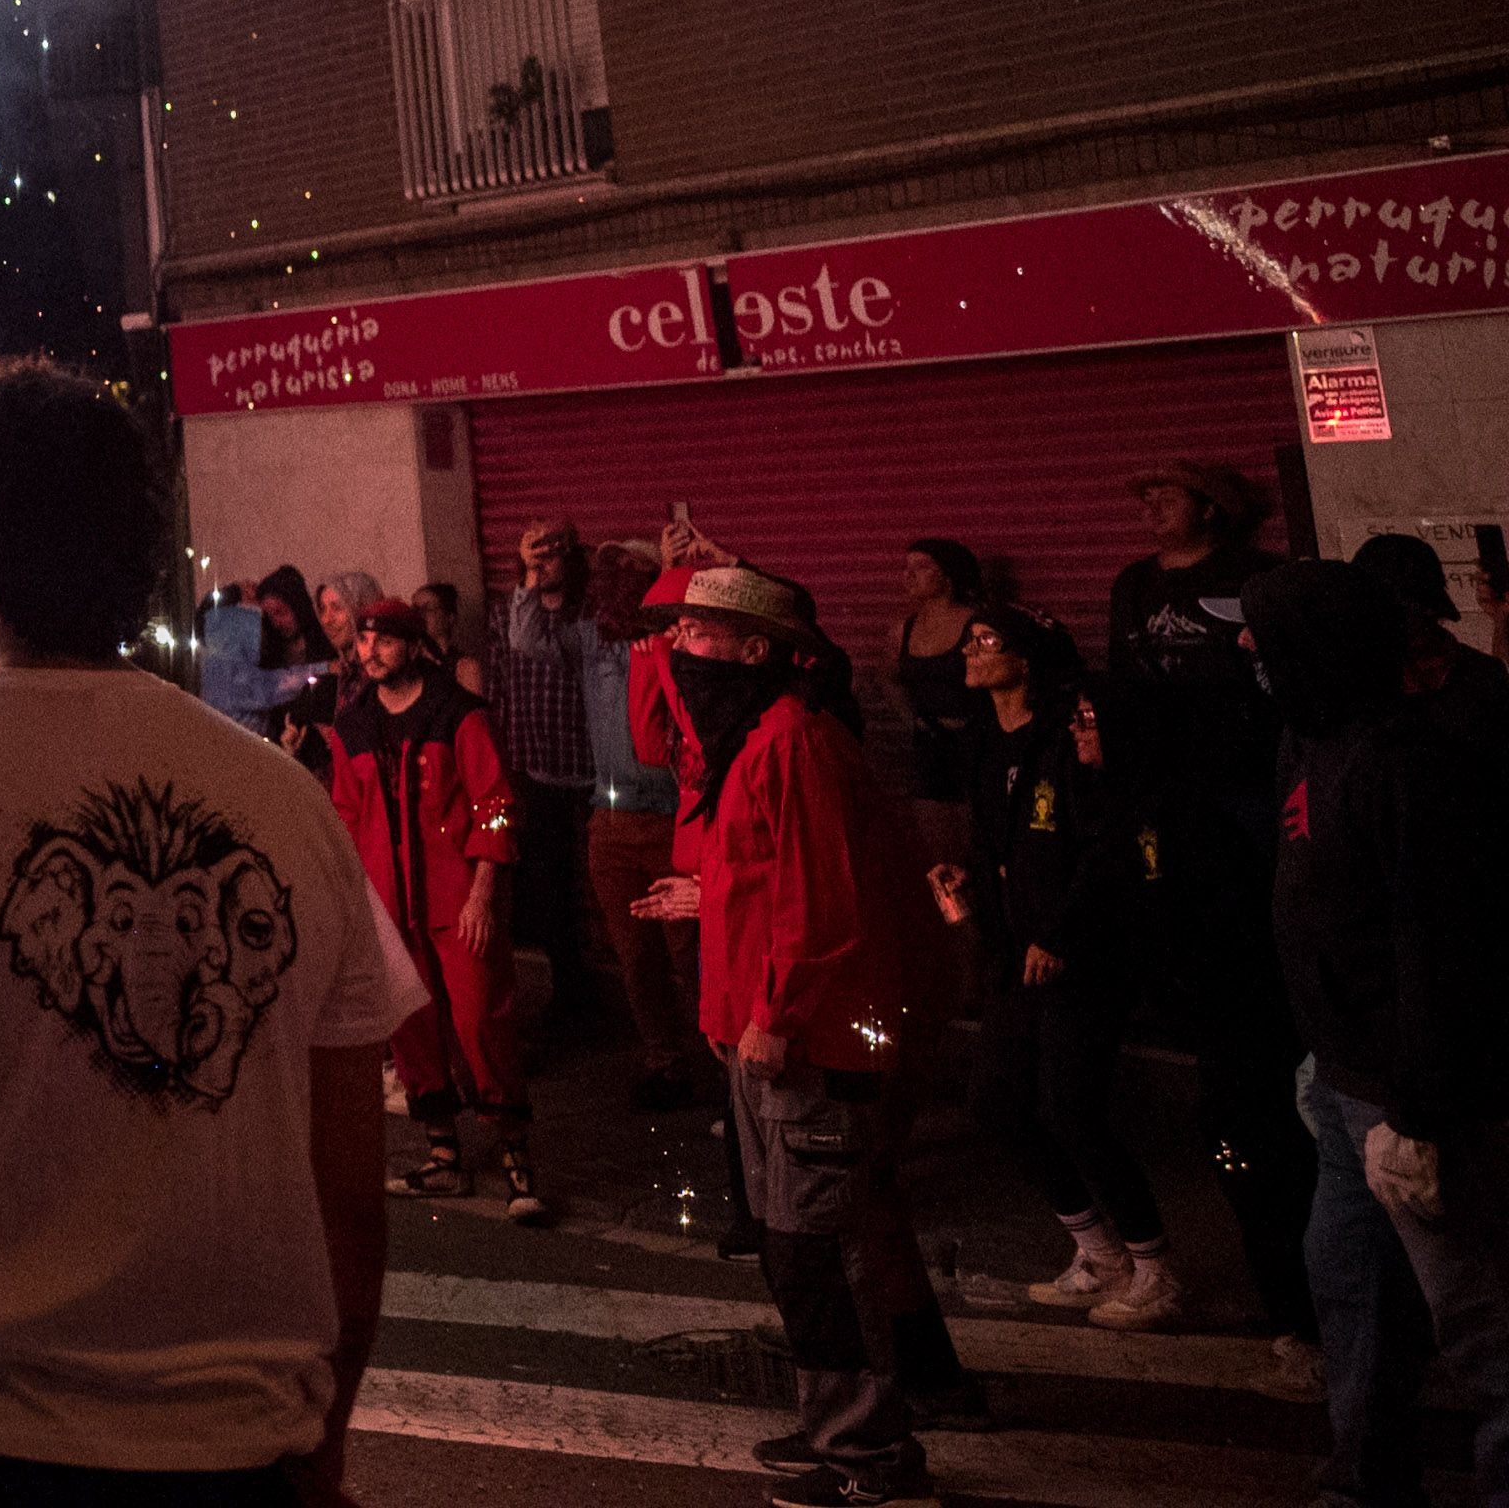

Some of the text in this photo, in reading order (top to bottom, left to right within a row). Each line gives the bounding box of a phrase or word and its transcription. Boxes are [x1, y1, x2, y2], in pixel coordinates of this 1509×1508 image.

[1230, 196, 1509, 249] perruqu
[1289, 238, 1509, 290] naturi
[1308, 374, 1377, 390] Alarma
[1415, 523, 1478, 541] VEND
